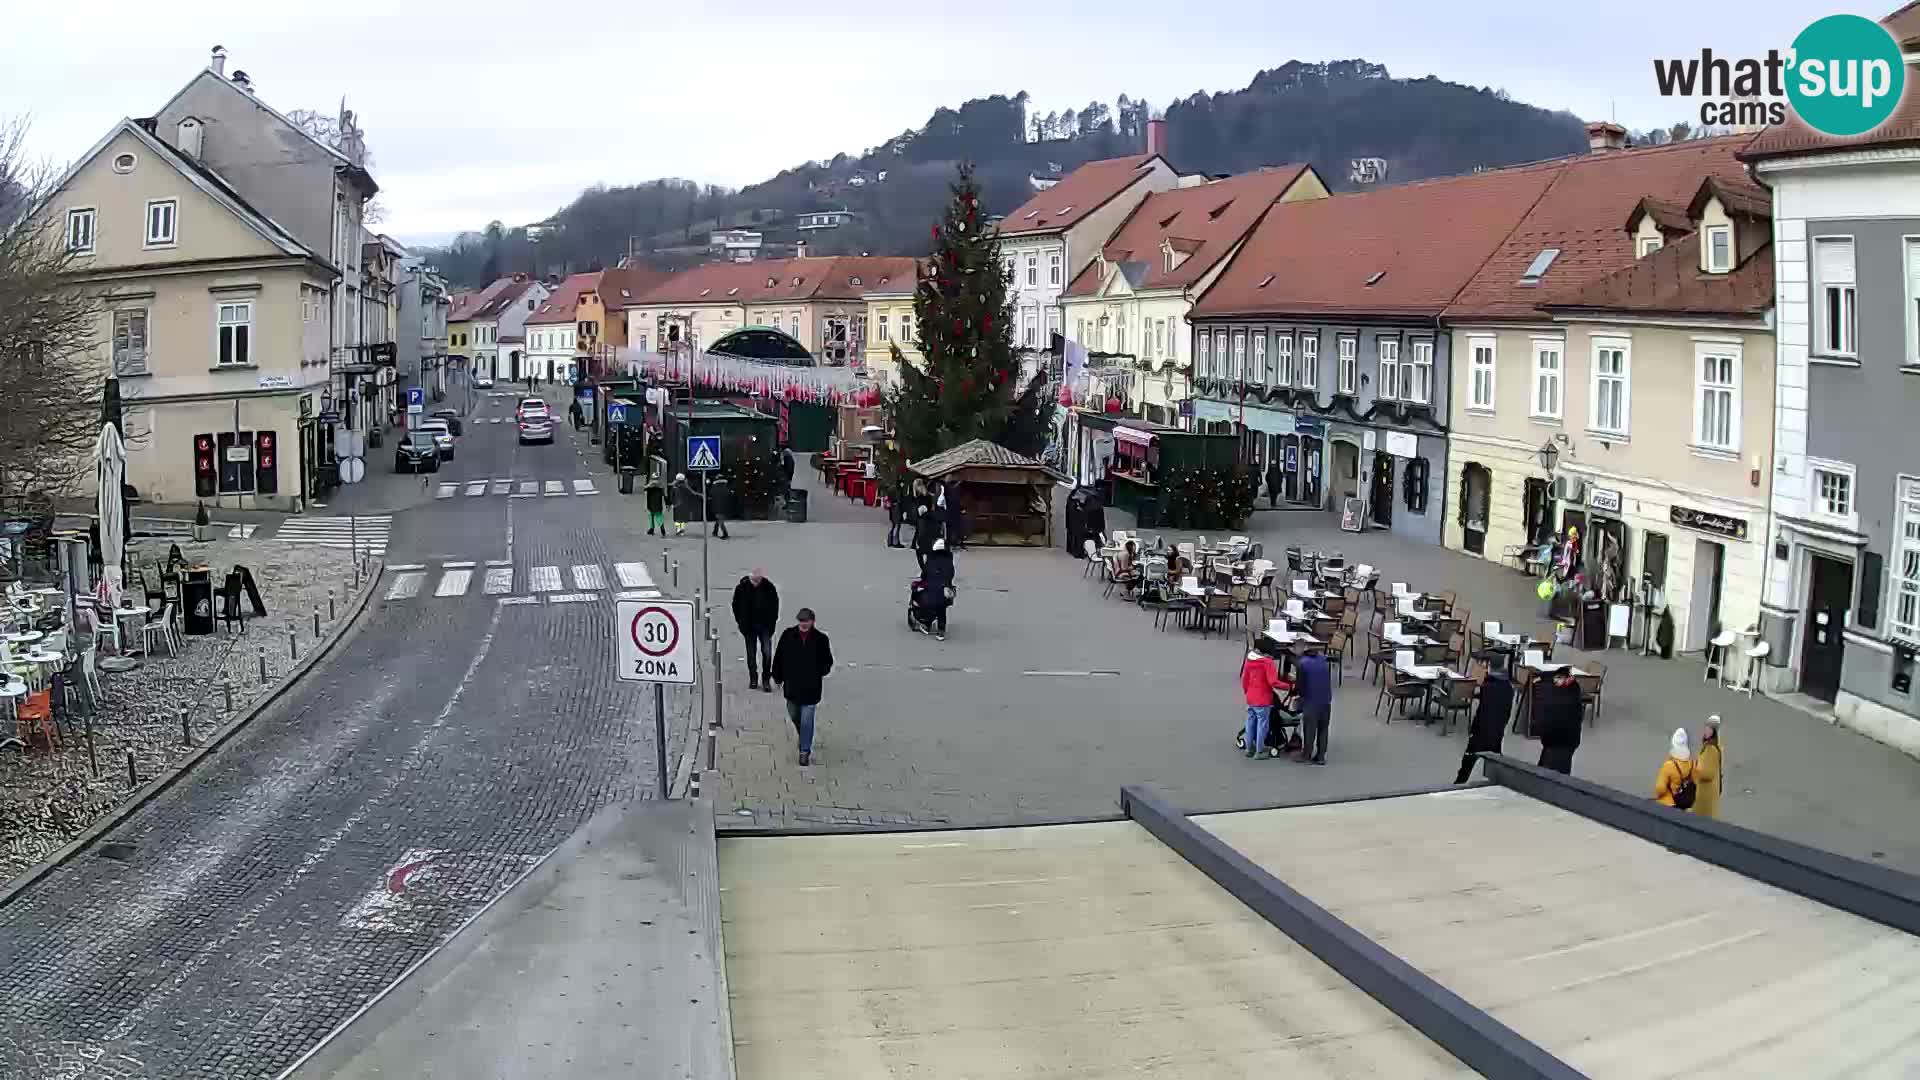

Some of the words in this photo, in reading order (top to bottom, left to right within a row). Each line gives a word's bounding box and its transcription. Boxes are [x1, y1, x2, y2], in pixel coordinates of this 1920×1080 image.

[411, 391, 419, 402] P
[644, 622, 668, 643] 30
[634, 659, 678, 677] ZONA
